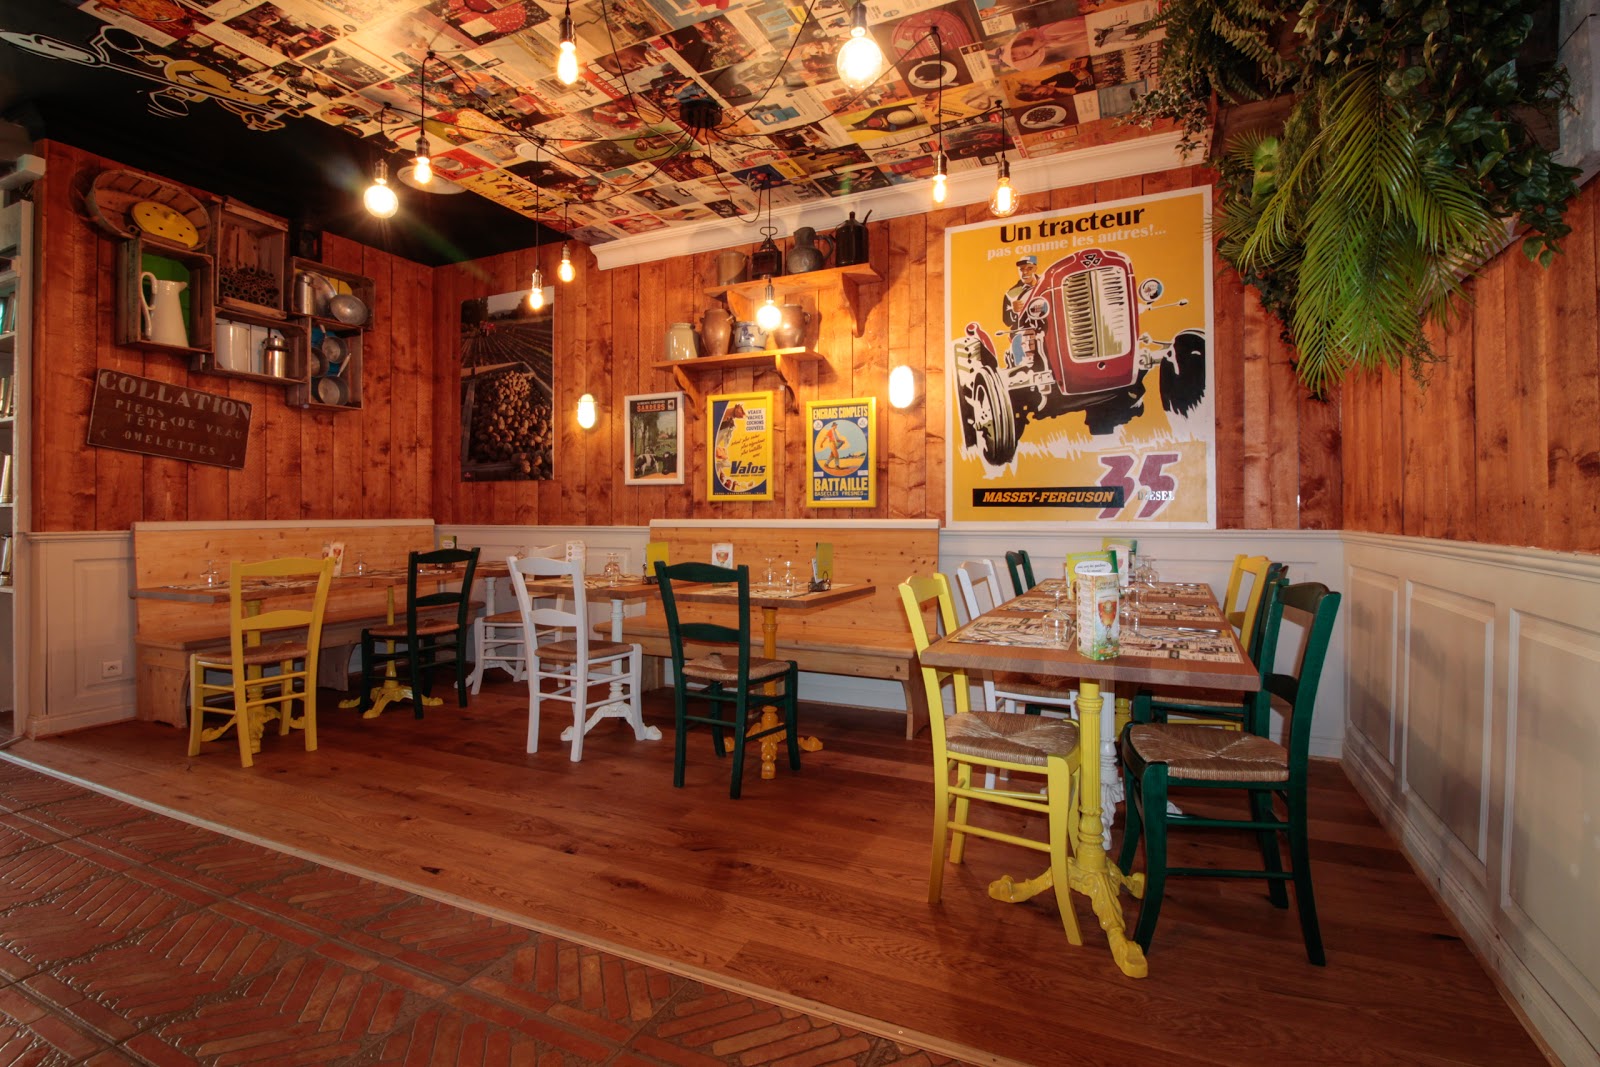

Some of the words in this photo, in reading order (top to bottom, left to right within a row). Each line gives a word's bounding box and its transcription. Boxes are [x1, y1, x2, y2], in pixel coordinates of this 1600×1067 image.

[1000, 224, 1031, 244] Un
[1040, 208, 1145, 238] tracteur
[987, 245, 1011, 261] pas
[1014, 238, 1069, 255] comme
[1072, 234, 1094, 248] les
[99, 371, 251, 421] COLLATION
[125, 413, 168, 431] TÊTE
[813, 407, 838, 420] ENGRAIS
[838, 405, 868, 419] COMPLETS
[178, 416, 197, 430] DE
[205, 423, 243, 440] VEAU
[124, 429, 217, 456] OMELETTES
[730, 460, 767, 474] Valos
[814, 477, 868, 492] BATTAILLE
[982, 491, 1114, 504] MASSEY-FERGUSON
